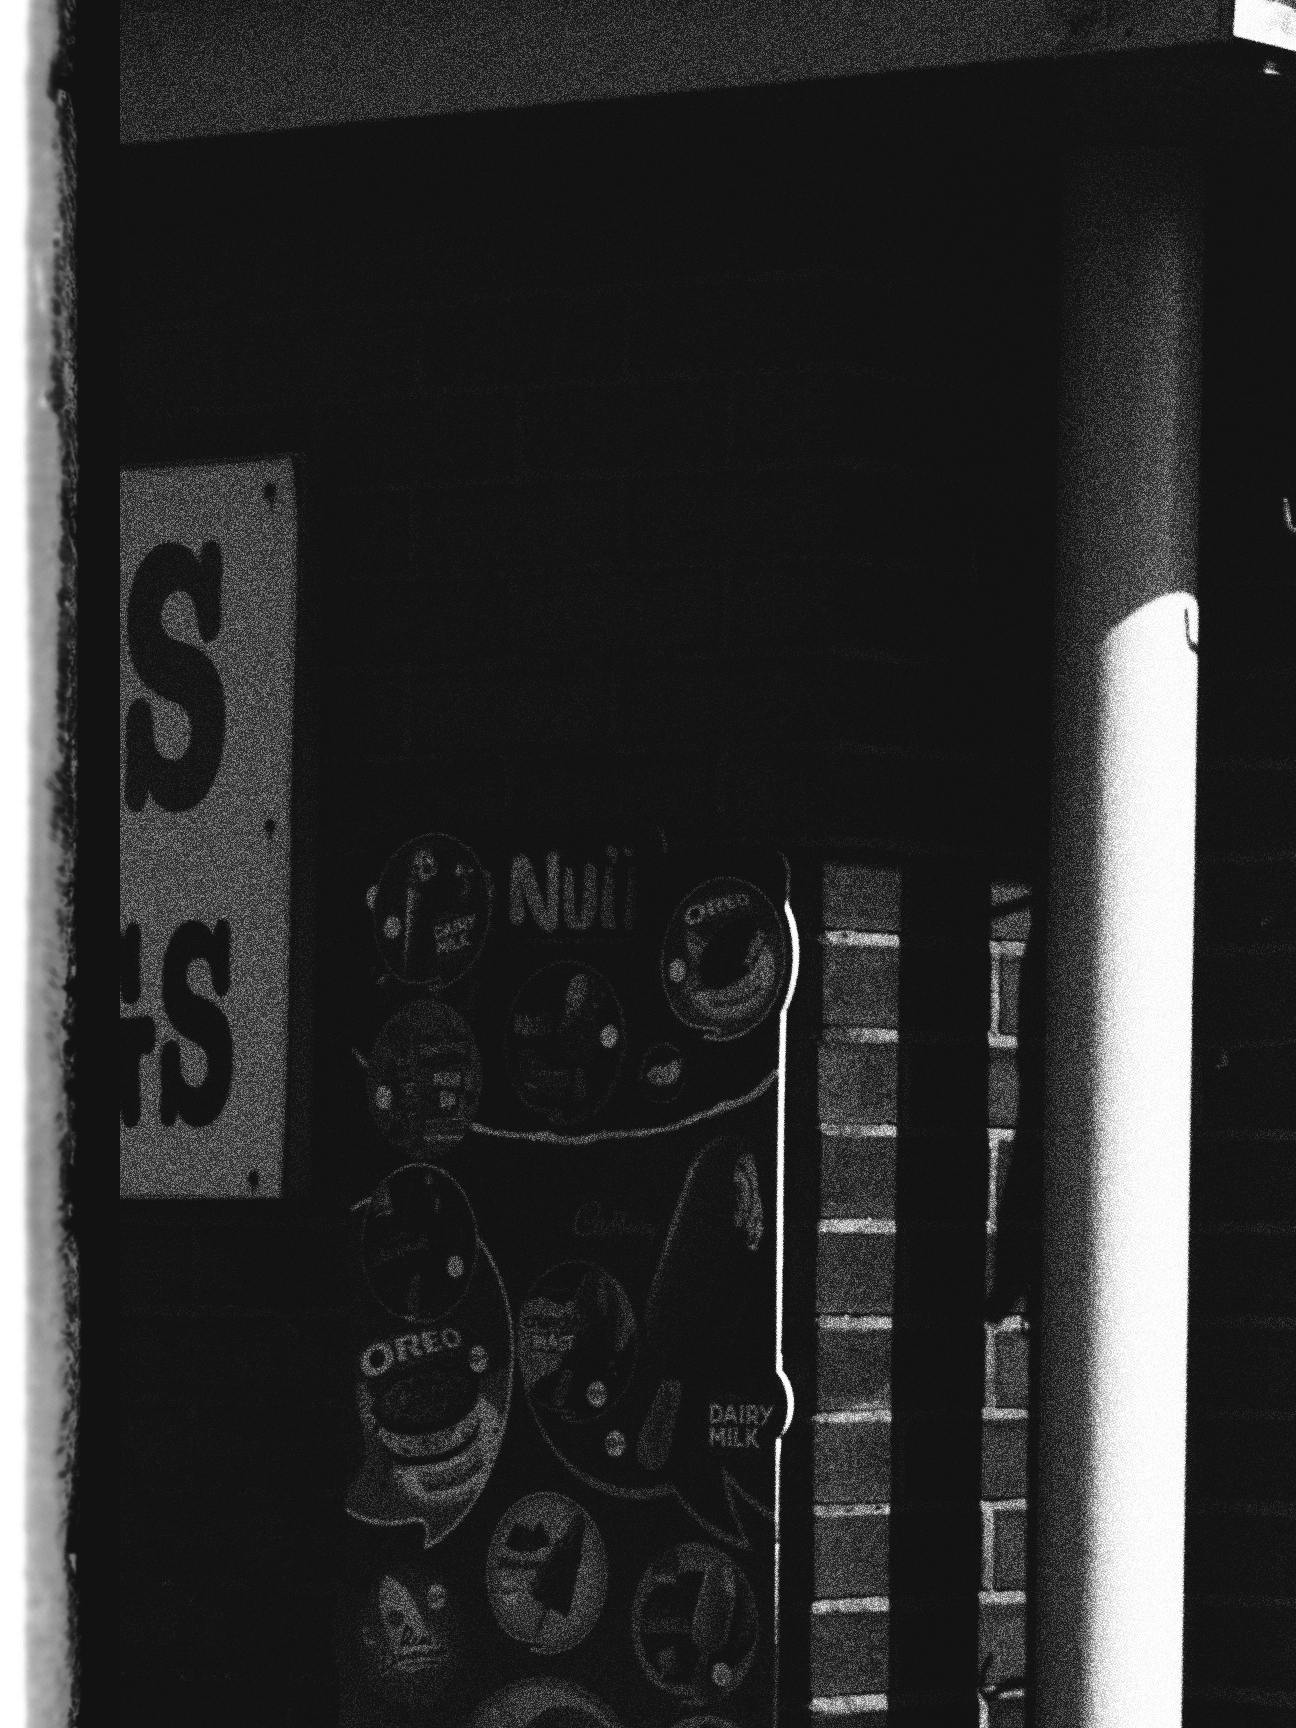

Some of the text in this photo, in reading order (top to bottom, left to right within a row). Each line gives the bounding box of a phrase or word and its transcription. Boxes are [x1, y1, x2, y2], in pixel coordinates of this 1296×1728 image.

[359, 1327, 463, 1379] OREO
[706, 1401, 775, 1427] DAIRY
[707, 1426, 762, 1450] MILK
